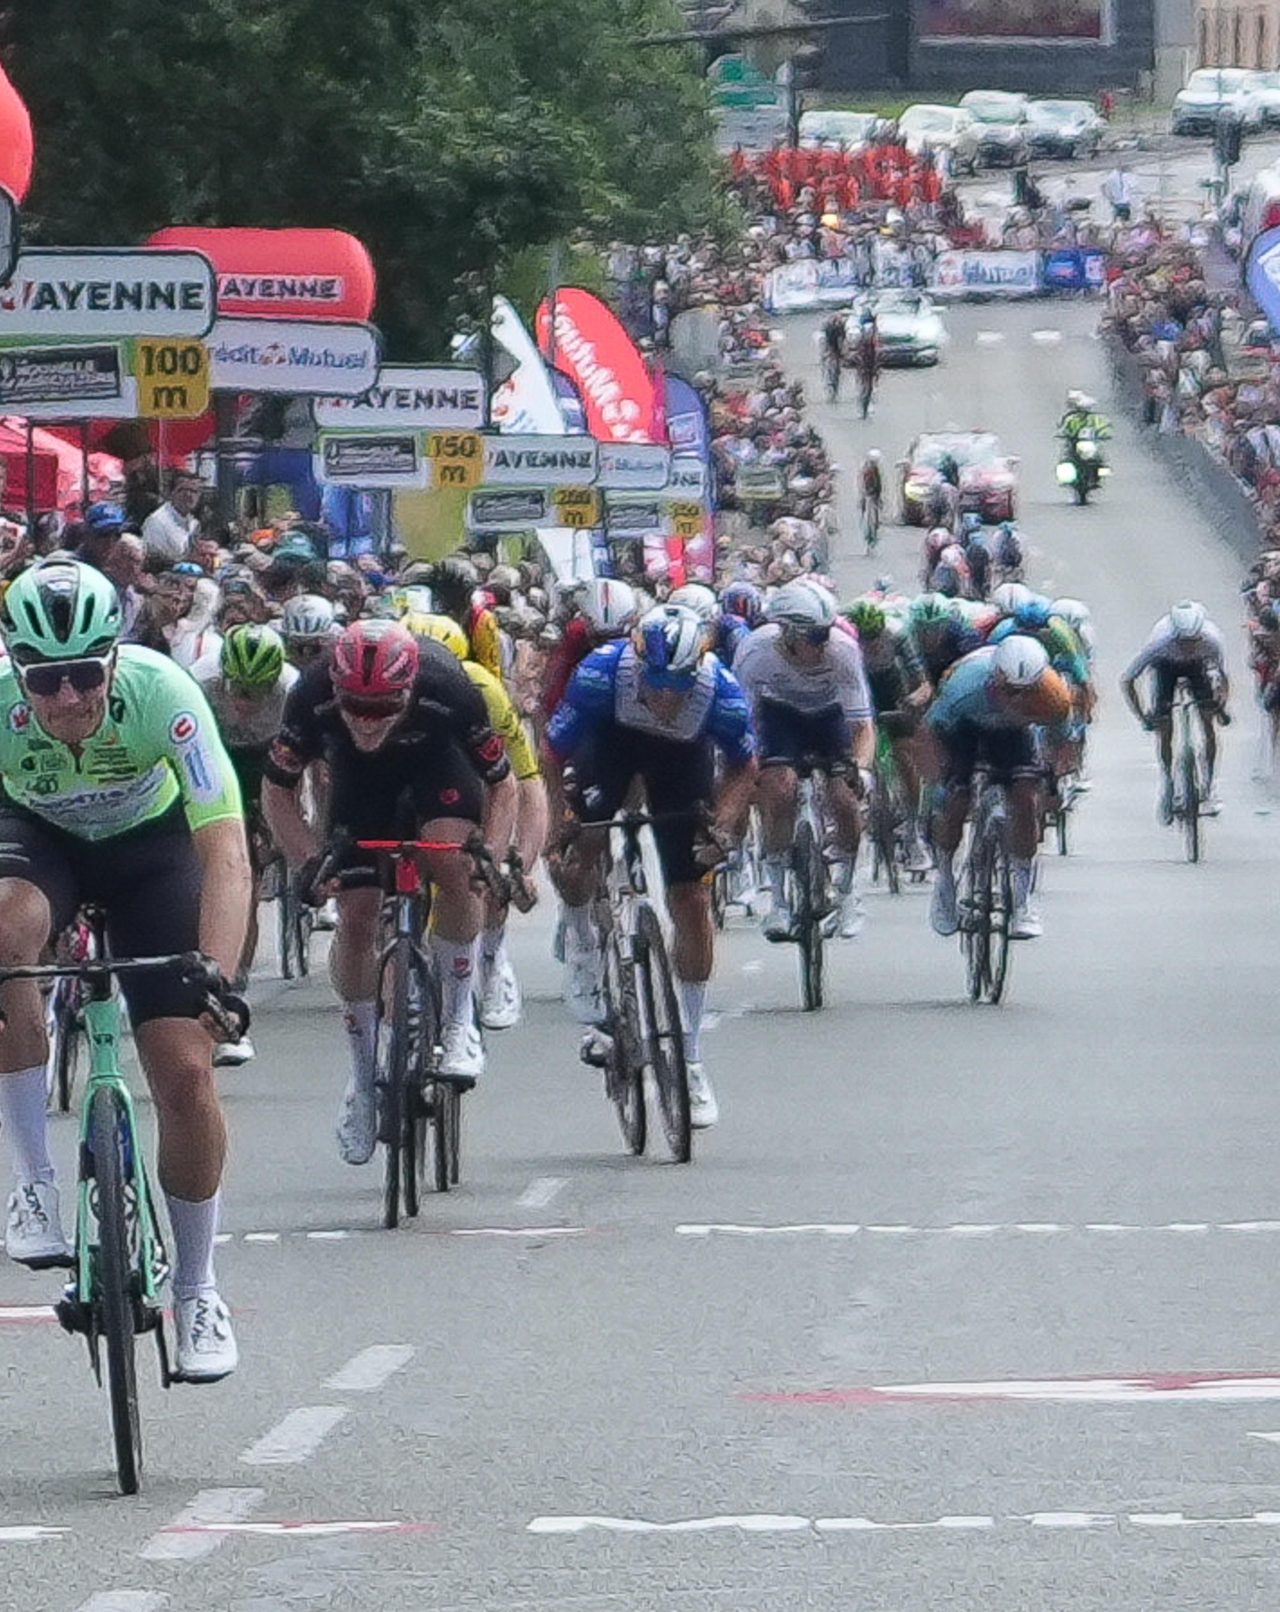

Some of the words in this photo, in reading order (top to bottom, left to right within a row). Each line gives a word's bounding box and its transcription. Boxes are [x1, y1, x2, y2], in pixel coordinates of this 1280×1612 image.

[222, 277, 339, 299] AYENNE
[140, 345, 202, 376] 100
[152, 386, 188, 409] m
[428, 434, 477, 458] 150
[440, 464, 467, 484] m
